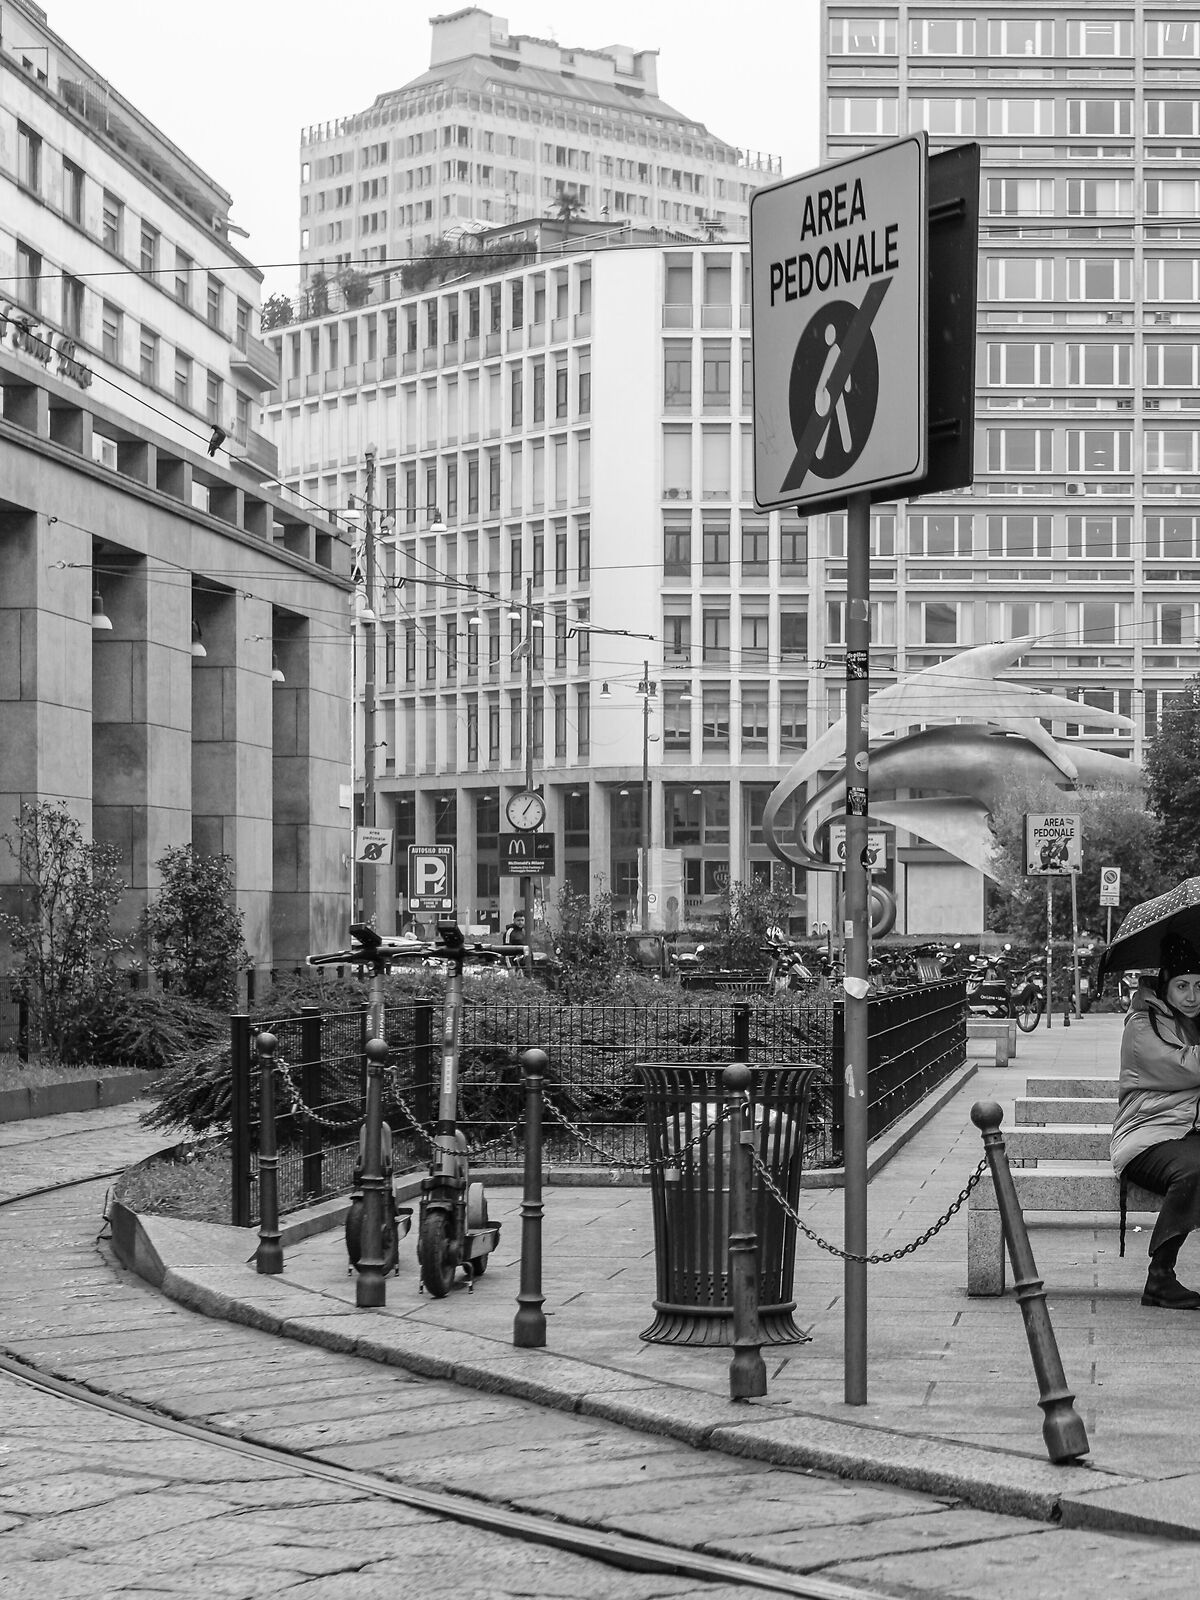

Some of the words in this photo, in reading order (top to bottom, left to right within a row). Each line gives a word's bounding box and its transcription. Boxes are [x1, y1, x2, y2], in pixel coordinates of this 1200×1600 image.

[800, 178, 866, 241] AREA
[770, 223, 899, 307] PEDONALE
[1044, 818, 1065, 826] AREA
[1034, 828, 1075, 837] PEDONALE
[417, 856, 446, 894] P
[366, 1015, 374, 1031] dott
[446, 1016, 454, 1034] dott
